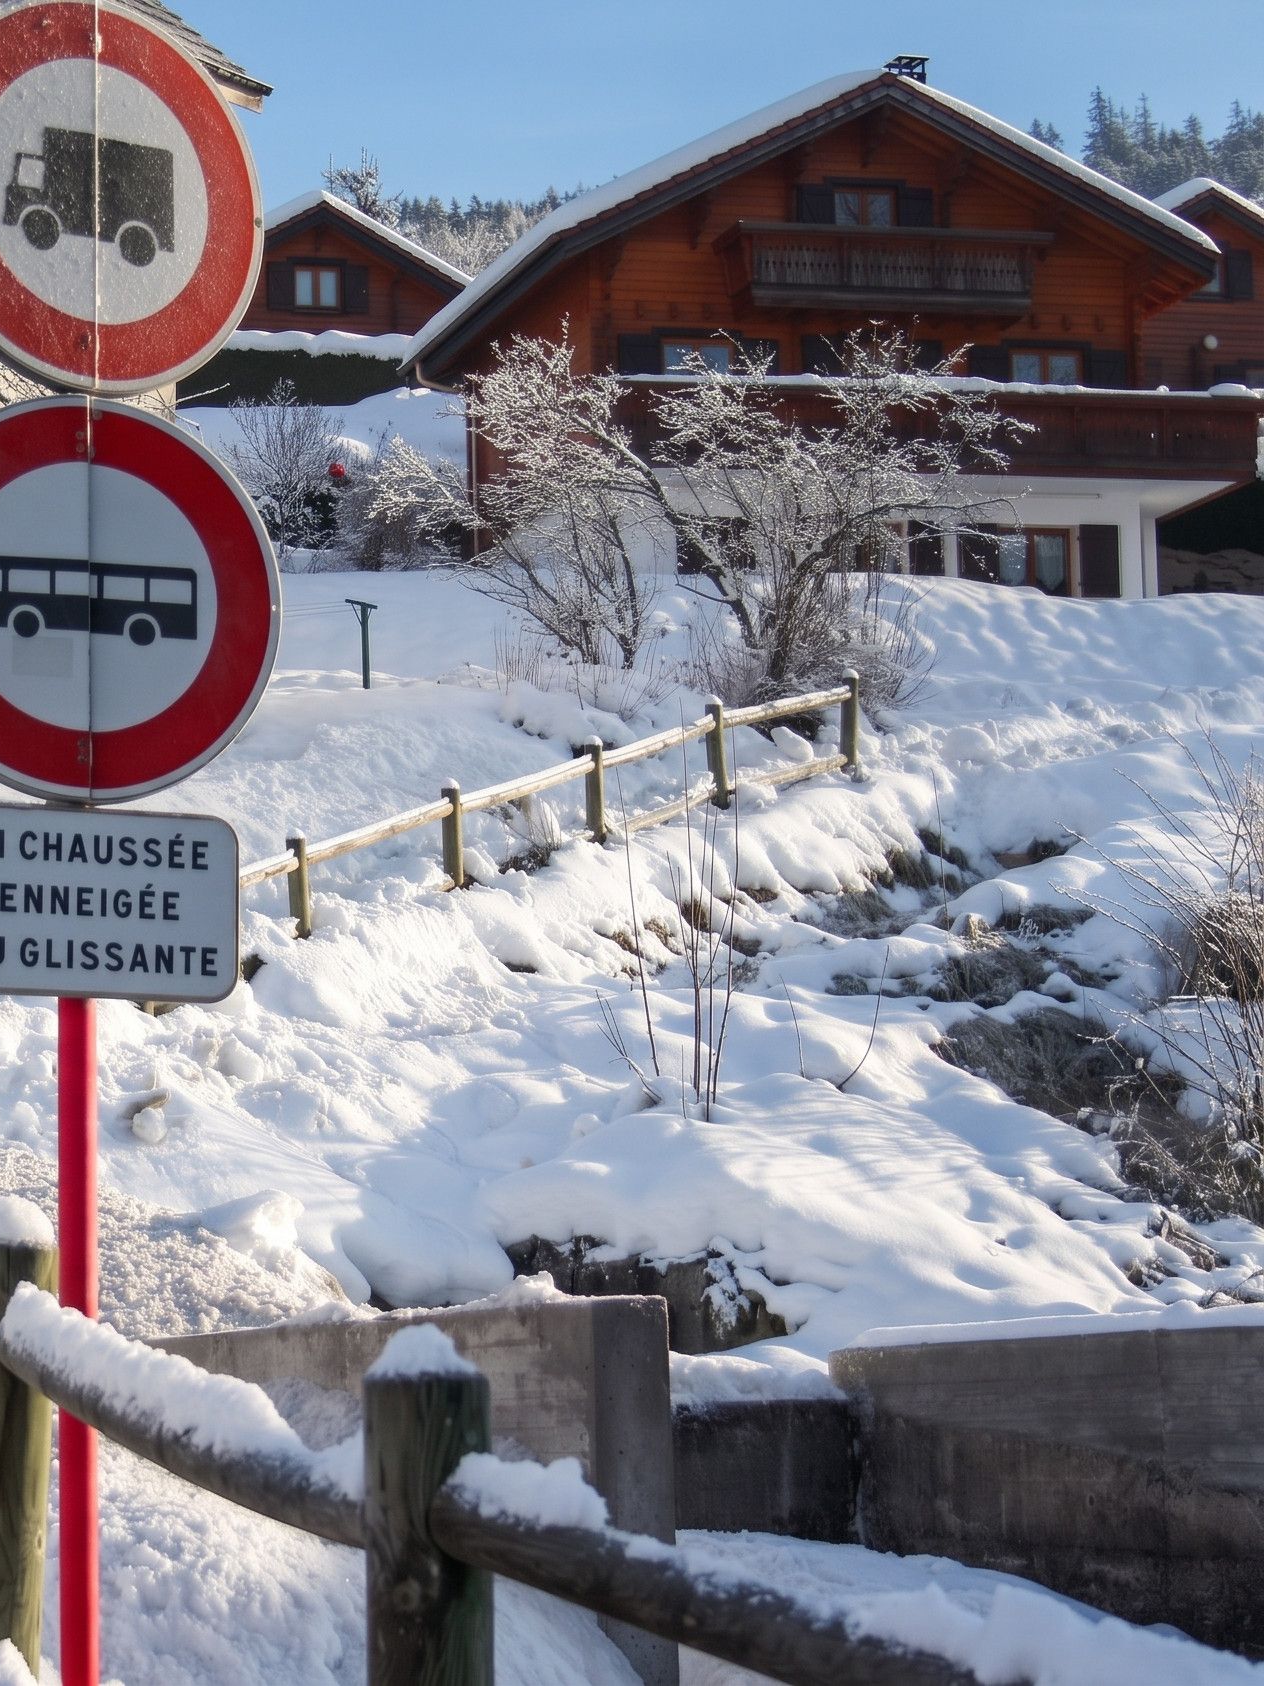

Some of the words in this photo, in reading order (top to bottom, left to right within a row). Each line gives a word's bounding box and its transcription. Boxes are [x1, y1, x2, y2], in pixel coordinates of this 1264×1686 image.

[18, 831, 209, 871] CHAUSSÉE
[0, 883, 180, 921] ENNEIGÉE
[19, 937, 218, 977] GLISSANTE
